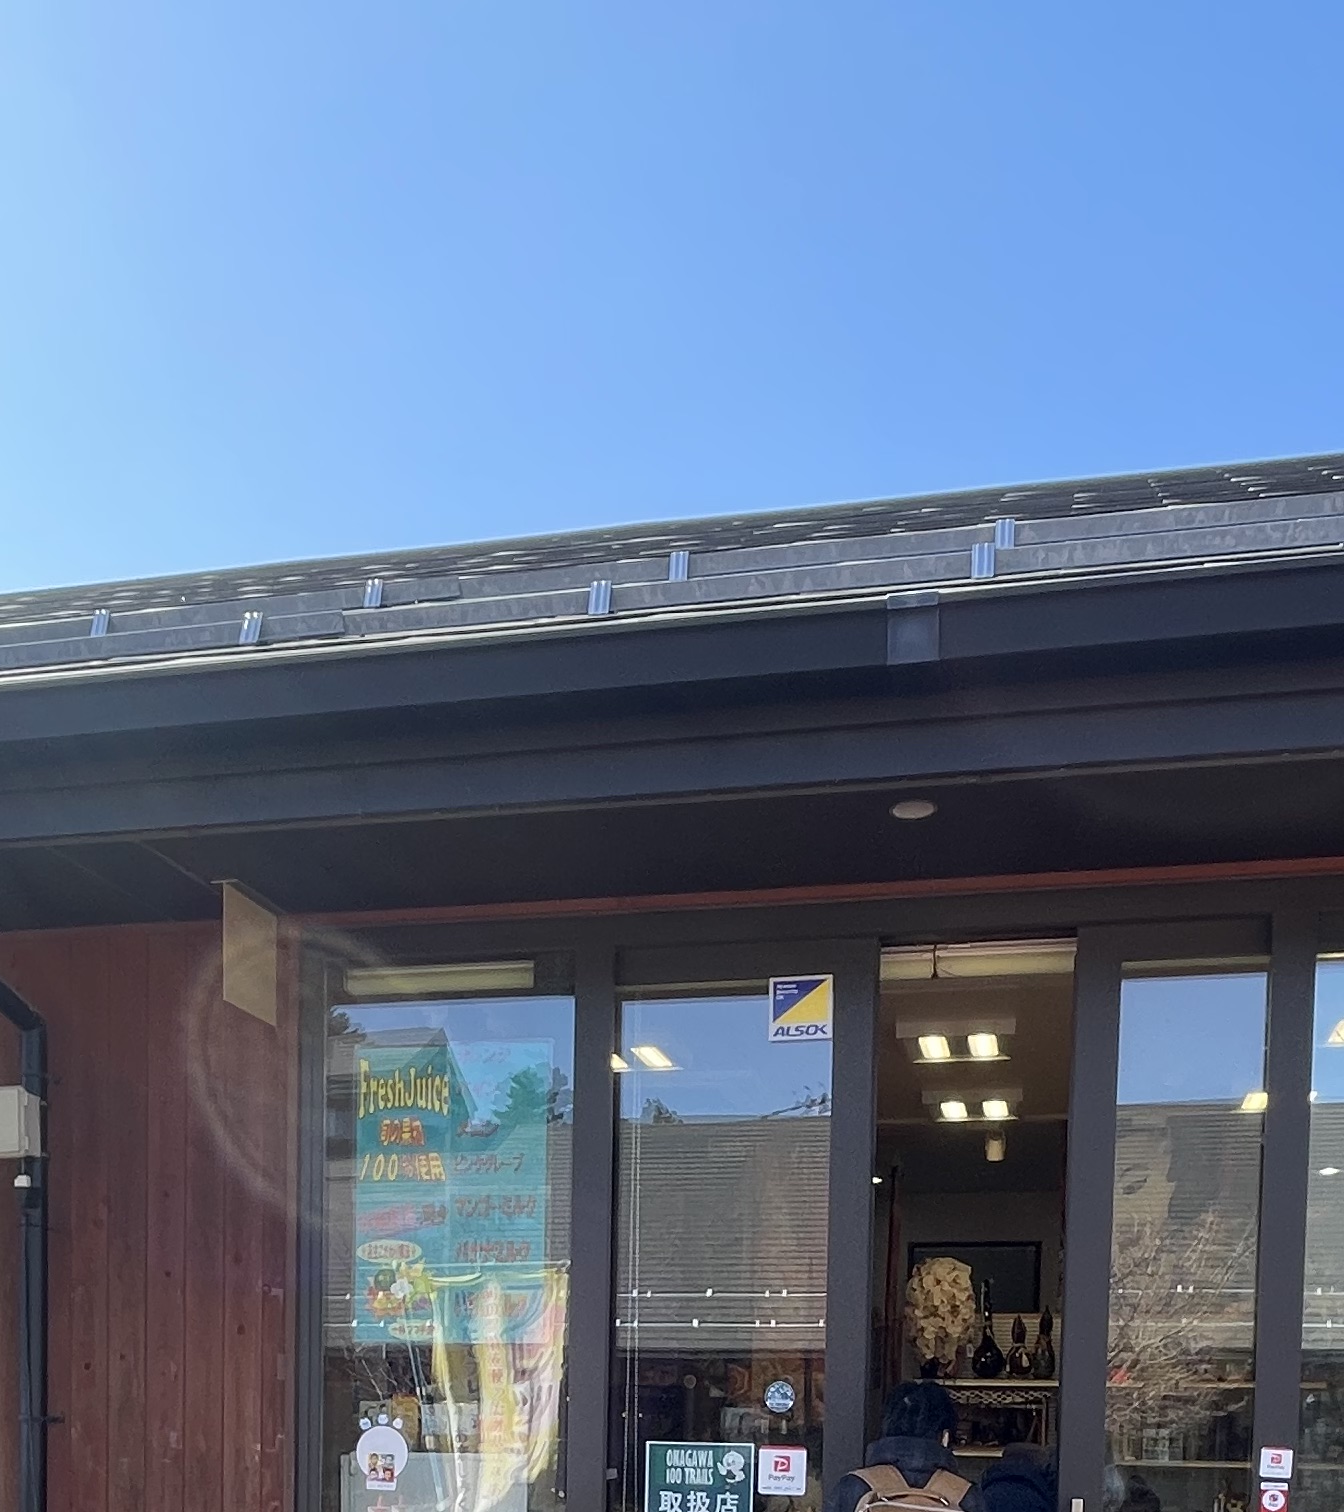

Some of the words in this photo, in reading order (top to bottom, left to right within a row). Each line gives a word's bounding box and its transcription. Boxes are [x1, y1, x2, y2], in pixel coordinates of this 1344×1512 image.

[773, 1023, 827, 1037] ALSOK
[666, 1449, 714, 1467] ONAGAWA
[666, 1468, 682, 1484] 100
[684, 1468, 714, 1485] TRAILS
[768, 1474, 795, 1482] PayPay
